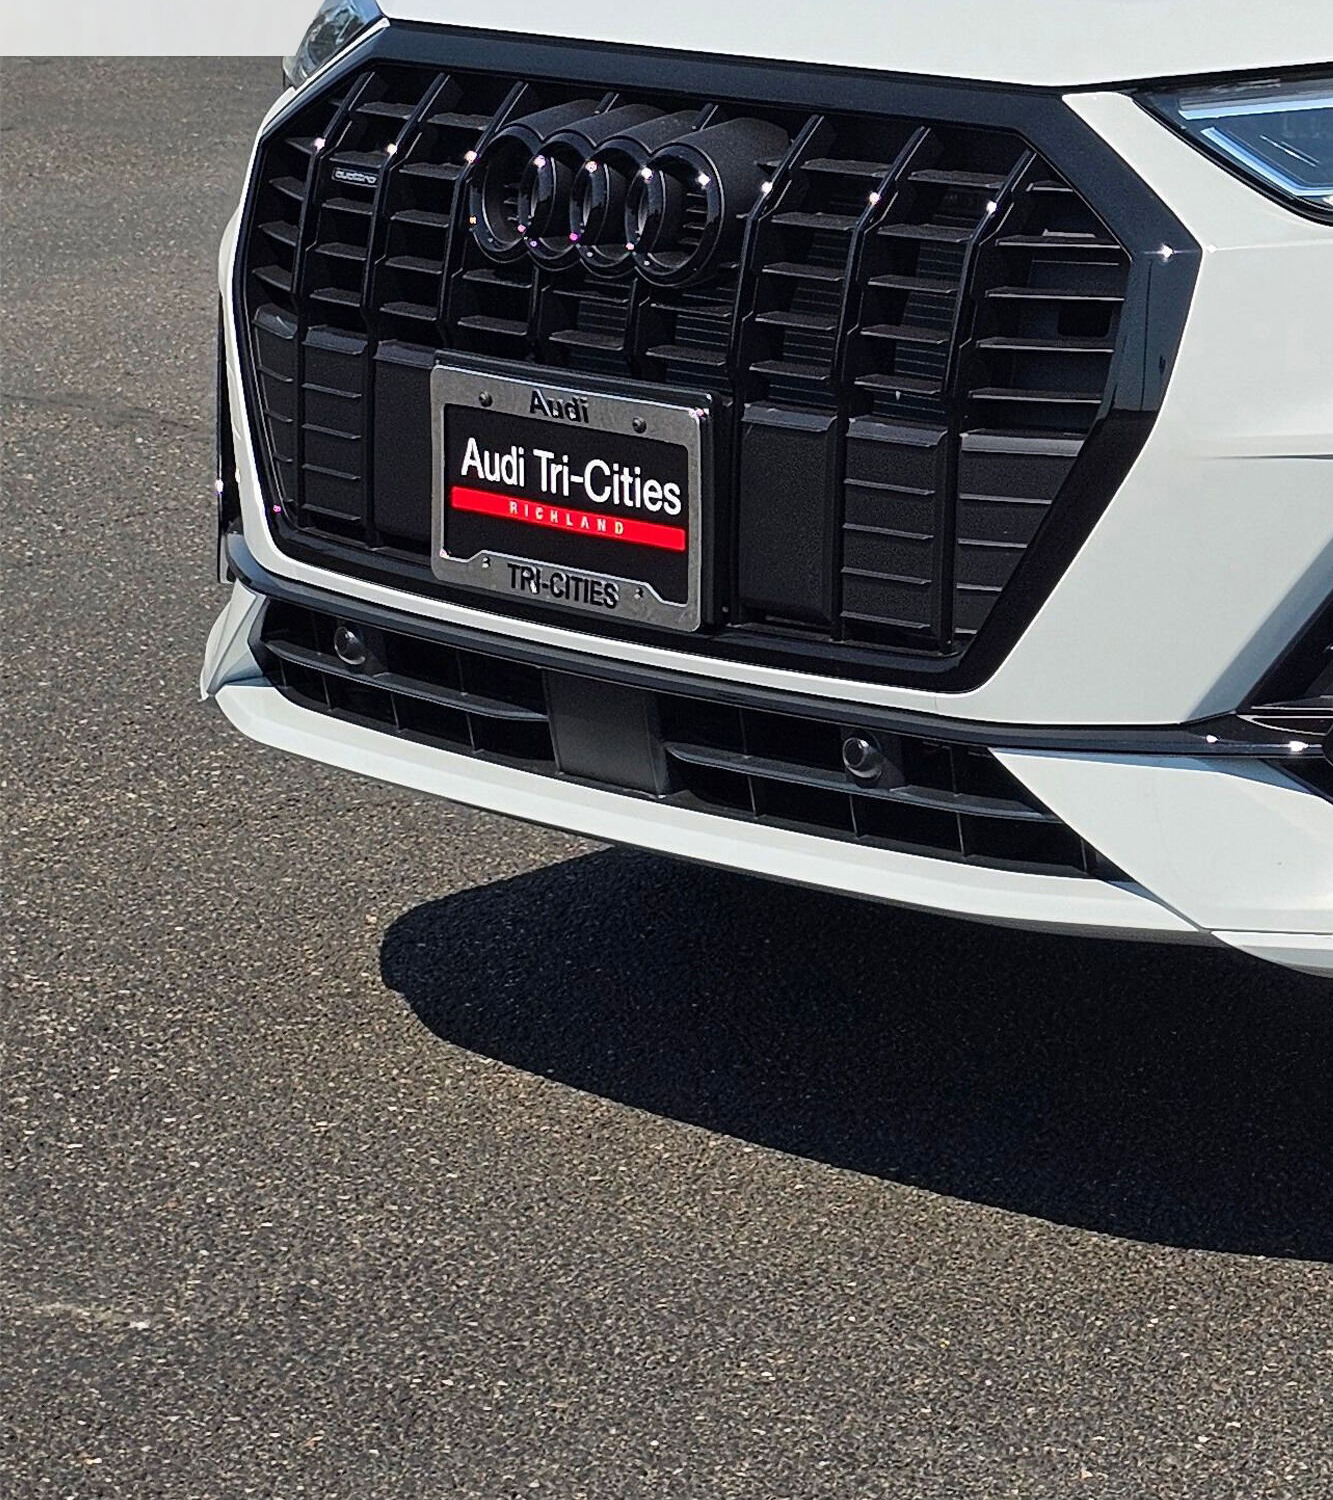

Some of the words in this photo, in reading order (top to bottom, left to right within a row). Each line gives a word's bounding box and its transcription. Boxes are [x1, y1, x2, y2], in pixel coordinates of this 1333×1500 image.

[529, 388, 590, 424] Audi
[460, 436, 526, 488] Audi
[532, 447, 682, 517] Tri-Cities
[508, 500, 626, 536] RICHLAND
[506, 562, 621, 610] TRI-CITIES
